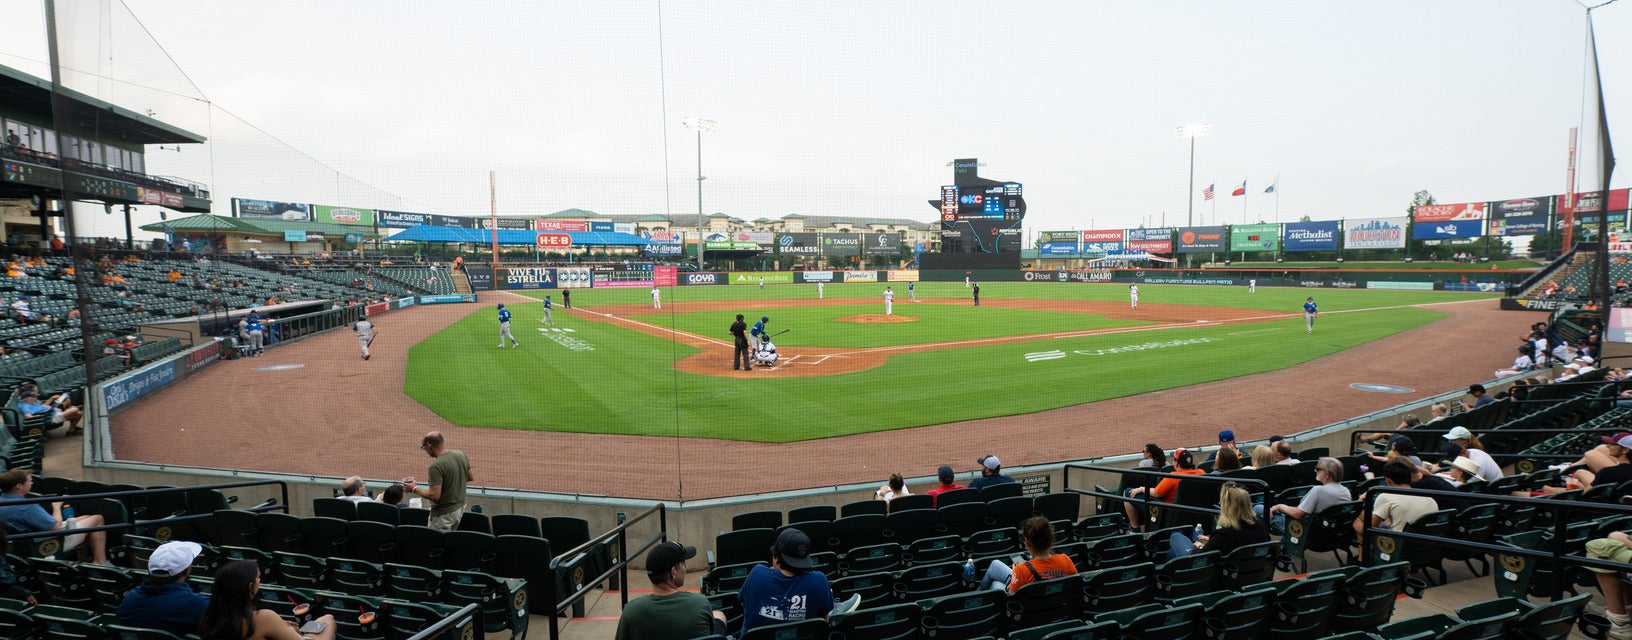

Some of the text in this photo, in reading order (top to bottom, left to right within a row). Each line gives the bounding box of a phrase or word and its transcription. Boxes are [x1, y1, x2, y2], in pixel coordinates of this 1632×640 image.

[1288, 230, 1333, 239] Methodist
[1350, 230, 1400, 241] HOUSTON
[508, 275, 552, 283] ESTRELLA
[790, 595, 807, 609] 21
